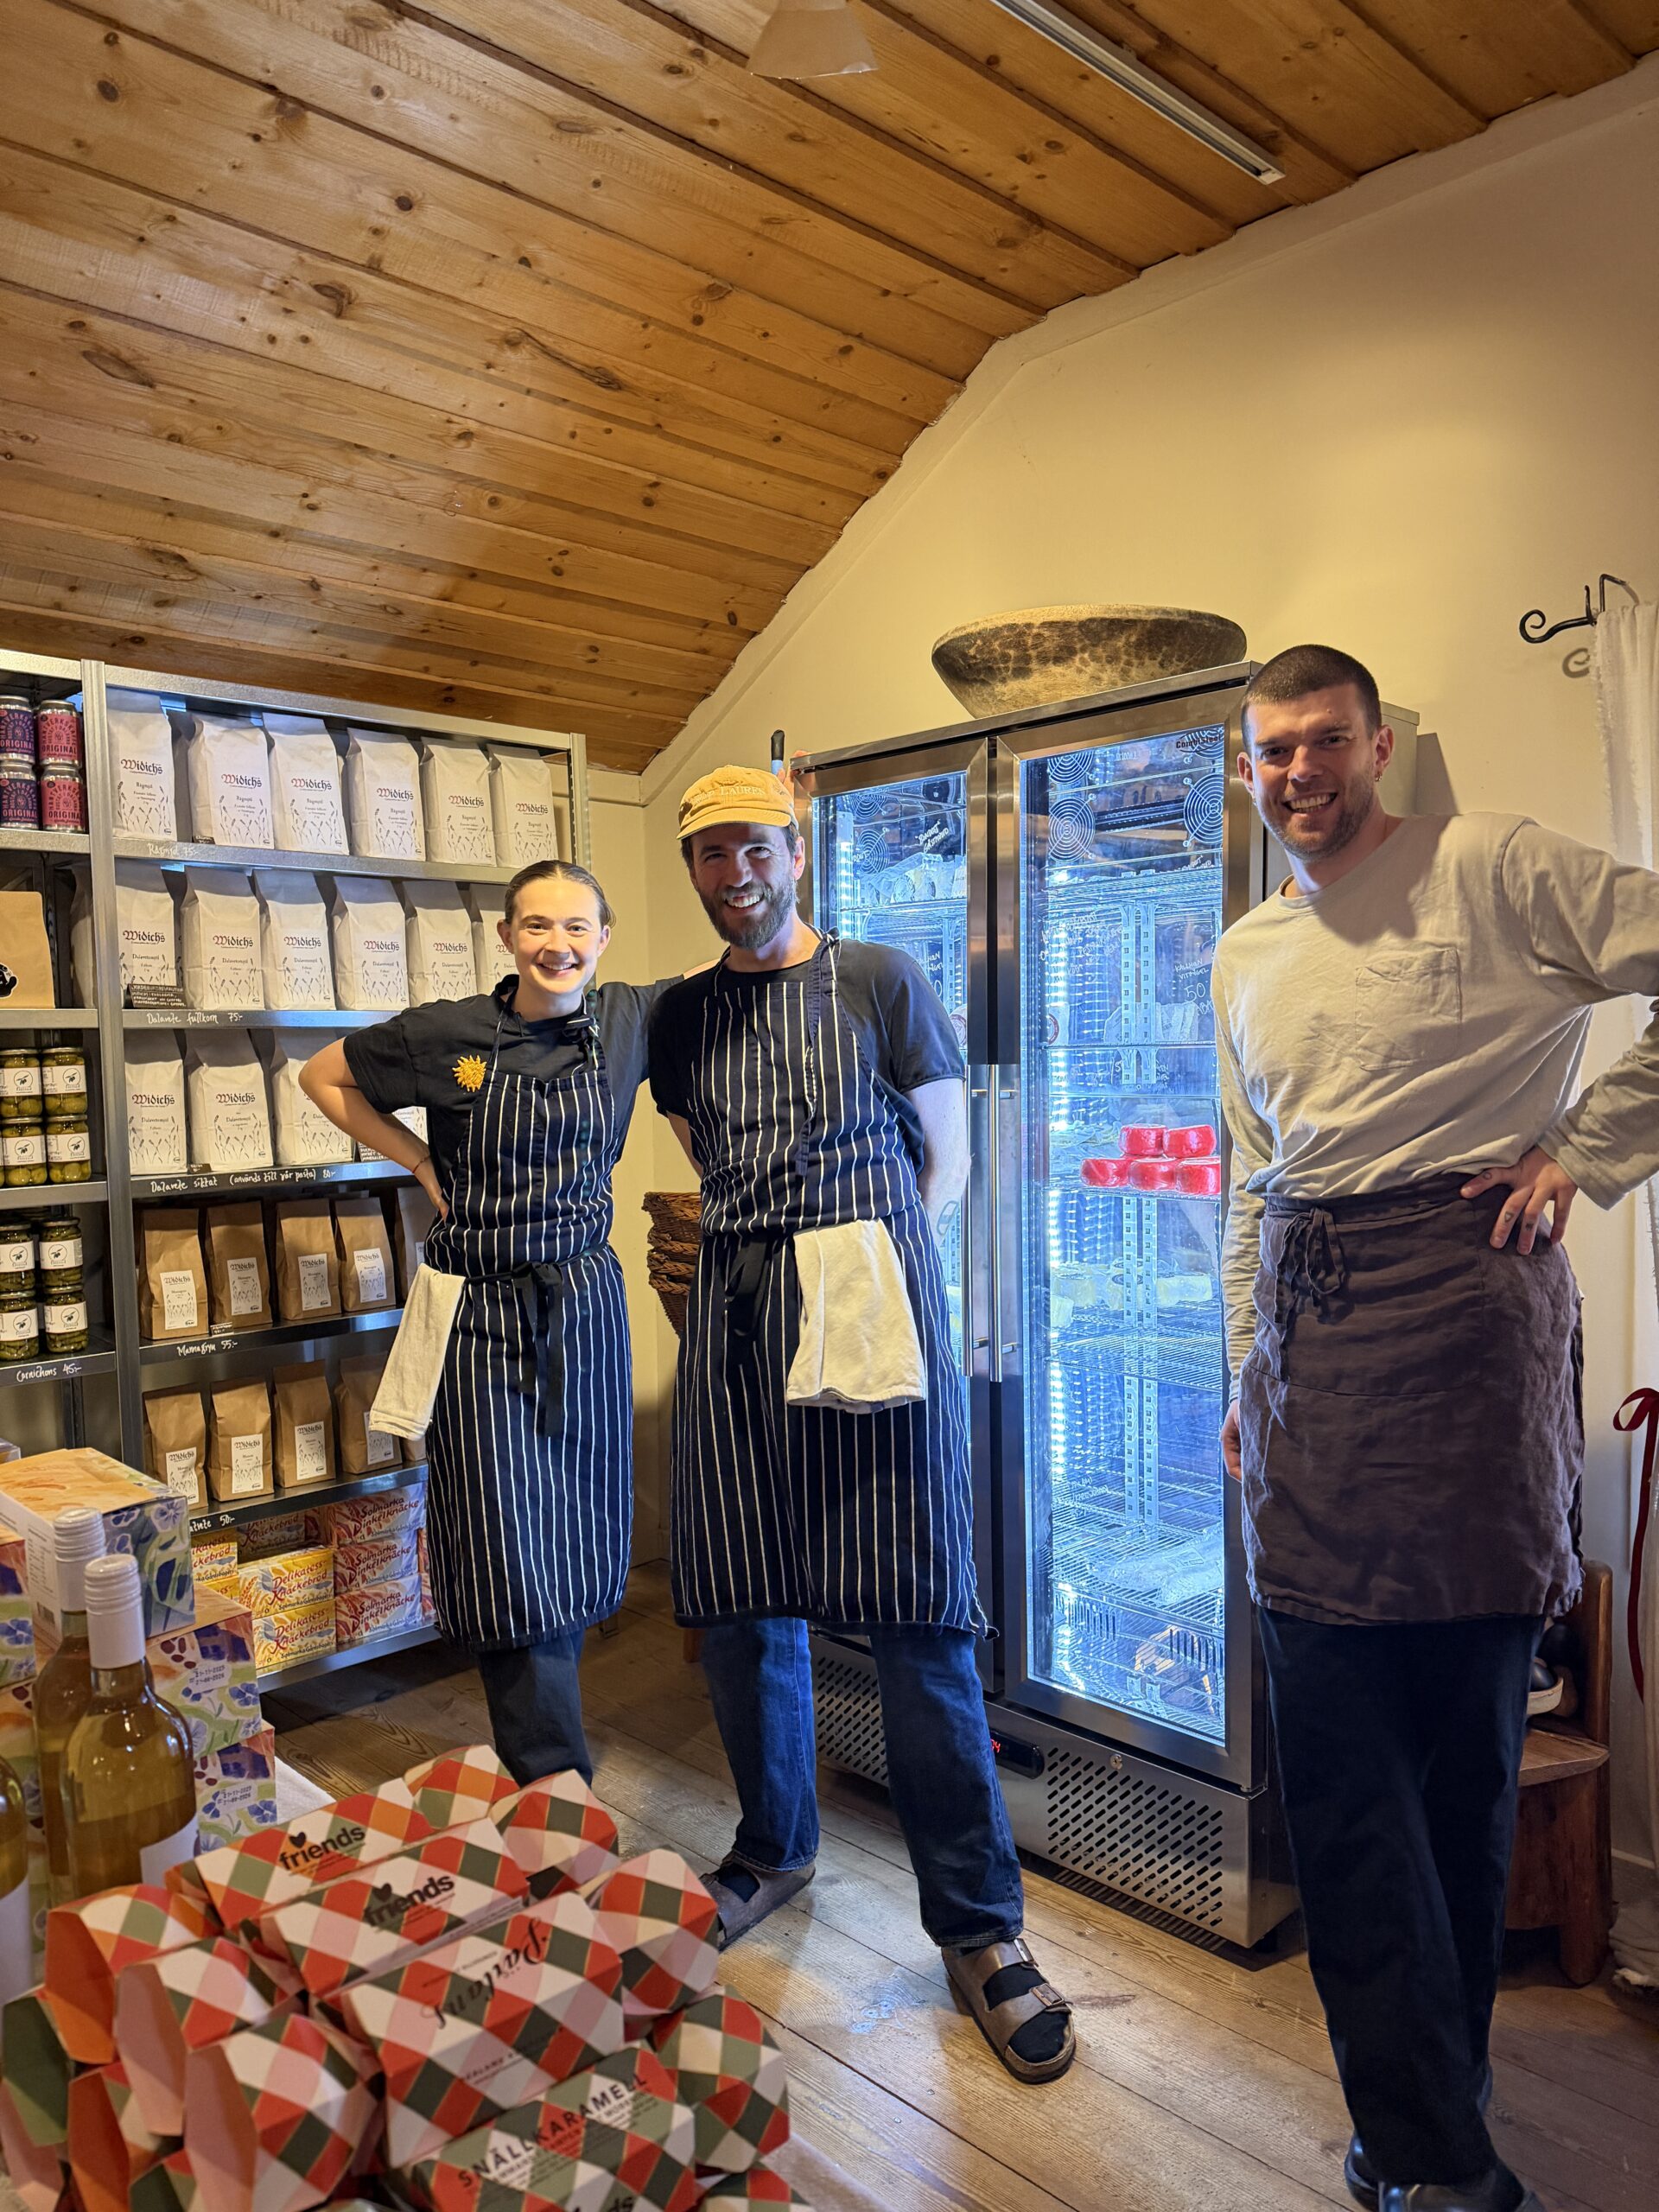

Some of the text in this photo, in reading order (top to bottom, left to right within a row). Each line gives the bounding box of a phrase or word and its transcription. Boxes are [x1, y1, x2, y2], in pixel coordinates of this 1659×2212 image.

[0, 740, 34, 750] ORIGINAL
[42, 745, 77, 754] ORIGINAL
[120, 759, 163, 775] Widichs
[221, 774, 262, 789] Widichs
[291, 778, 332, 791] Widichs
[377, 788, 414, 802] Widichs
[448, 795, 485, 807] Widichs
[3, 809, 37, 819] ORIGINAL
[48, 810, 83, 821] ORIGINAL
[515, 803, 549, 815] Widichs
[123, 930, 165, 944] Widichs
[213, 935, 253, 949] Widichs
[284, 936, 321, 950] Widichs
[364, 940, 400, 953] Widichs
[433, 942, 468, 955] Widichs
[1184, 982, 1206, 1003] 50
[131, 1094, 175, 1107] Widichs
[216, 1092, 256, 1105] Widichs
[264, 1171, 277, 1182] till
[16, 1365, 57, 1382] Cornichons
[360, 1497, 405, 1519] Solmarka
[352, 1500, 420, 1538] Dinkelknäcke
[192, 1534, 229, 1555] ikatess-
[193, 1546, 232, 1568] ckebröd
[355, 1543, 398, 1567] Solmarka
[346, 1546, 412, 1586] Dinkelknäcke
[359, 1592, 402, 1615] Solmarka
[349, 1594, 416, 1633] Dinkelknäcke
[279, 1826, 366, 1871] friends
[364, 1874, 455, 1927] friends
[458, 2073, 646, 2188] SNÄLLKARAMELL
